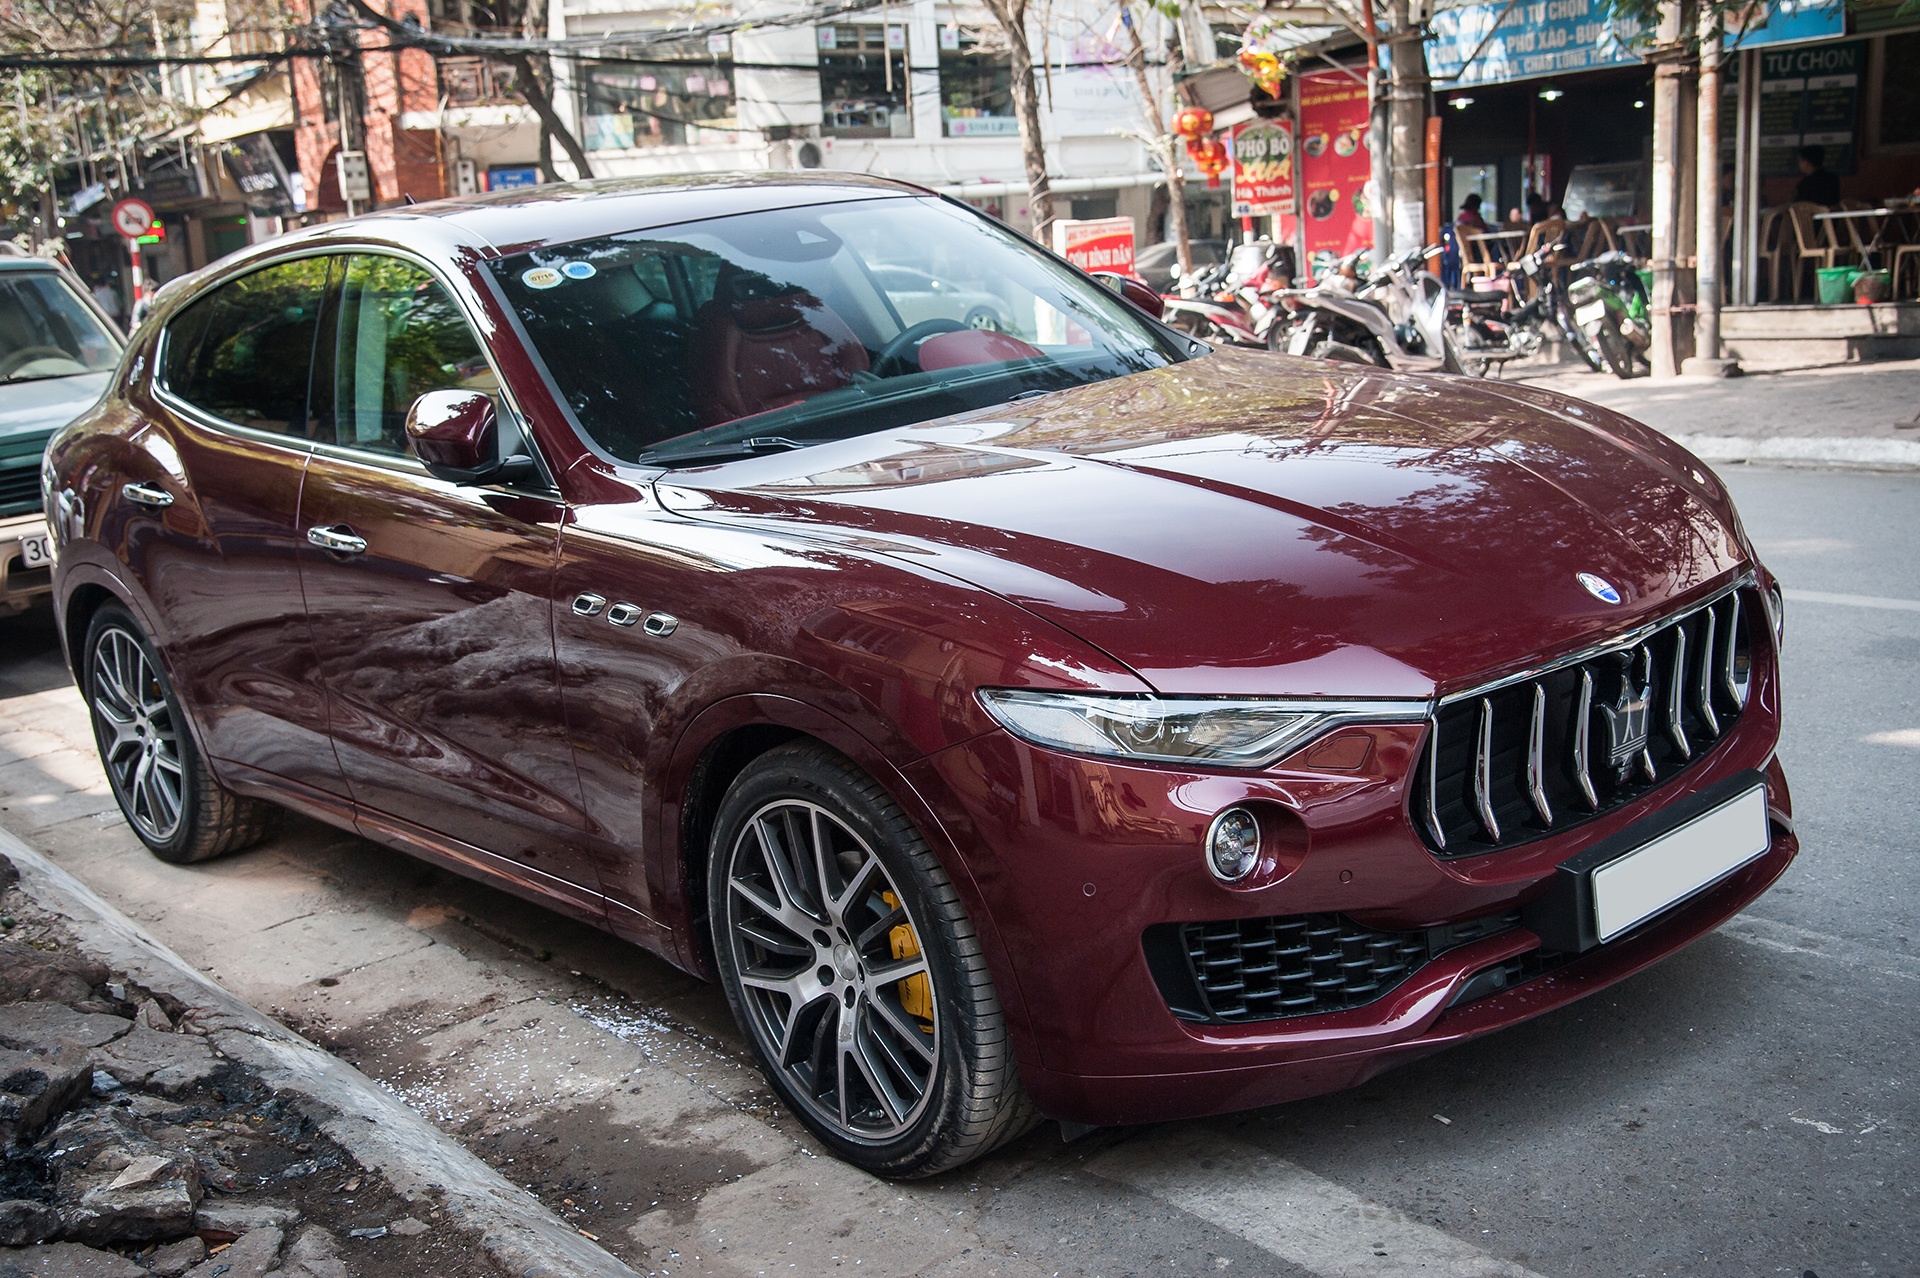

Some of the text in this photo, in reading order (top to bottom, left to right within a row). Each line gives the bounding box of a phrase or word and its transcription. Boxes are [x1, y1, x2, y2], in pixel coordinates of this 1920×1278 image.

[1549, 0, 1588, 21] CHỌN
[1766, 54, 1794, 76] TỰ
[1797, 49, 1856, 73] CHỌN
